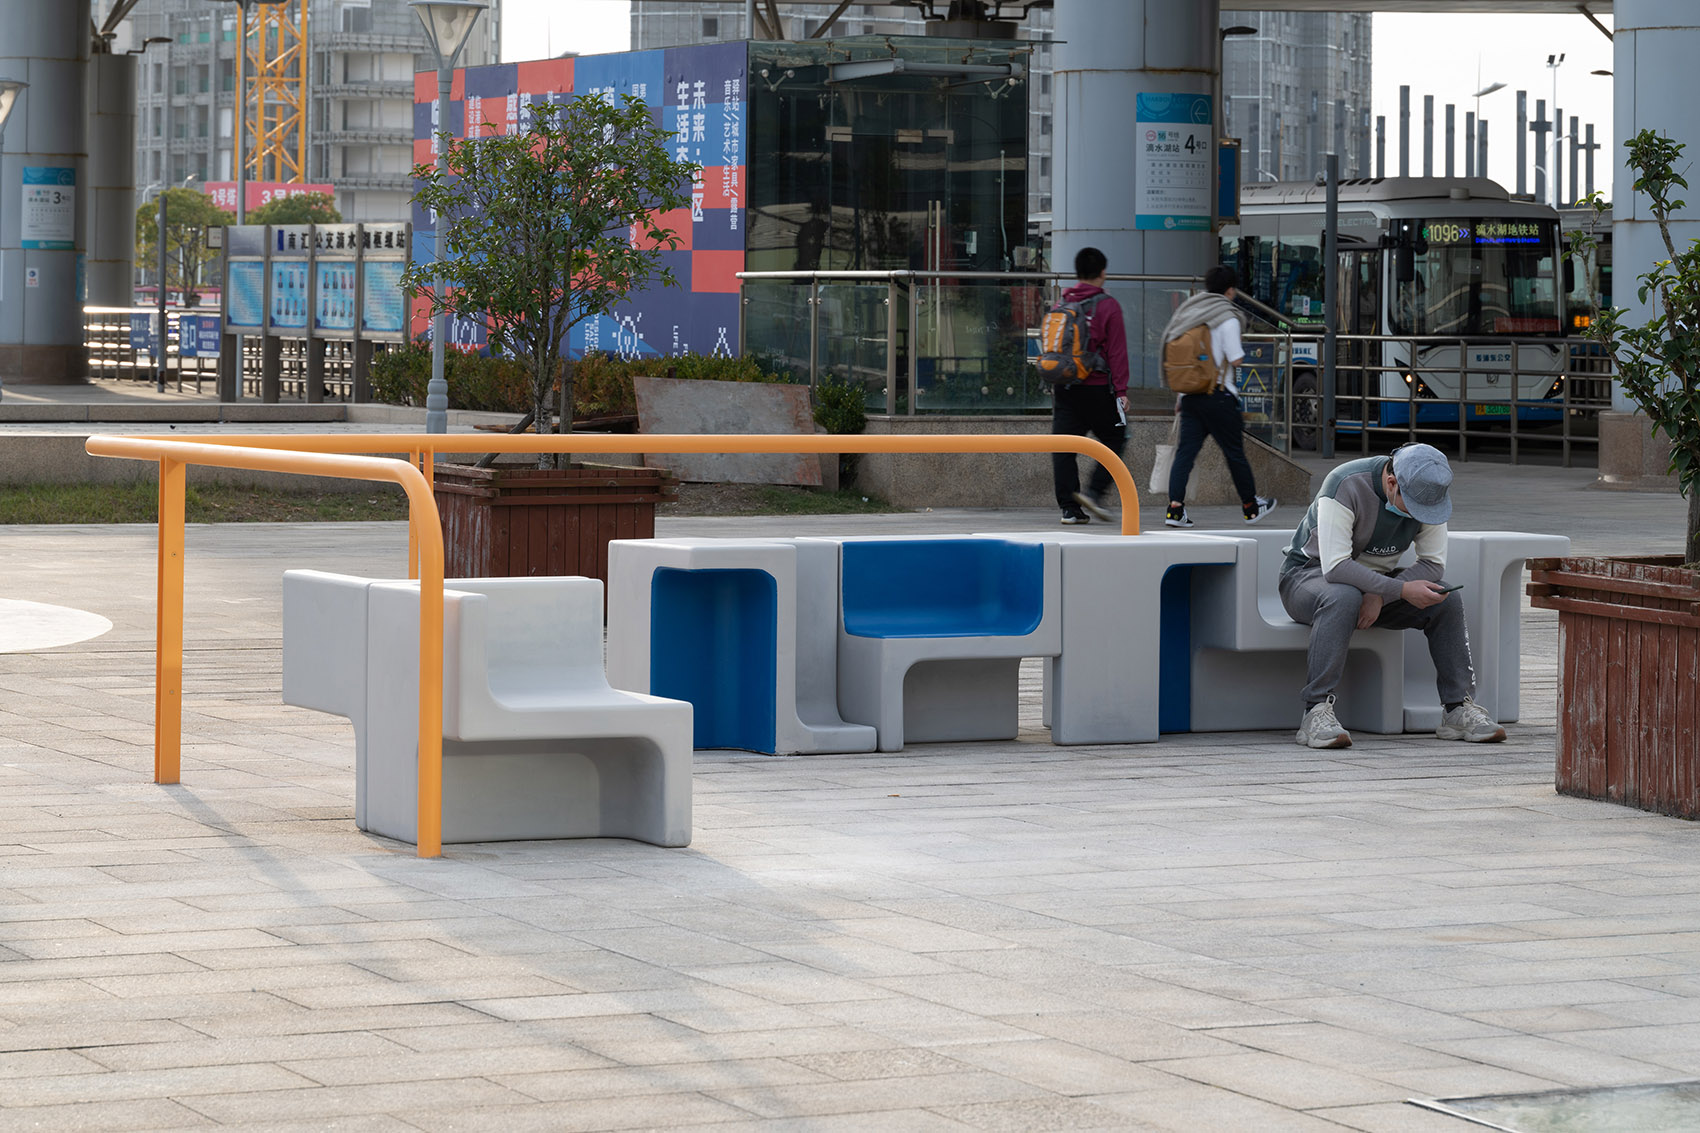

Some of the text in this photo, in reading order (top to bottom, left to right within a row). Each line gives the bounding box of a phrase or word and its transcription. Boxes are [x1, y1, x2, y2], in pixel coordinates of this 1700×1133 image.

[1146, 143, 1181, 153] 滴水湖站
[1428, 224, 1460, 243] 1096
[1475, 223, 1540, 236] 滴水湖地铁站
